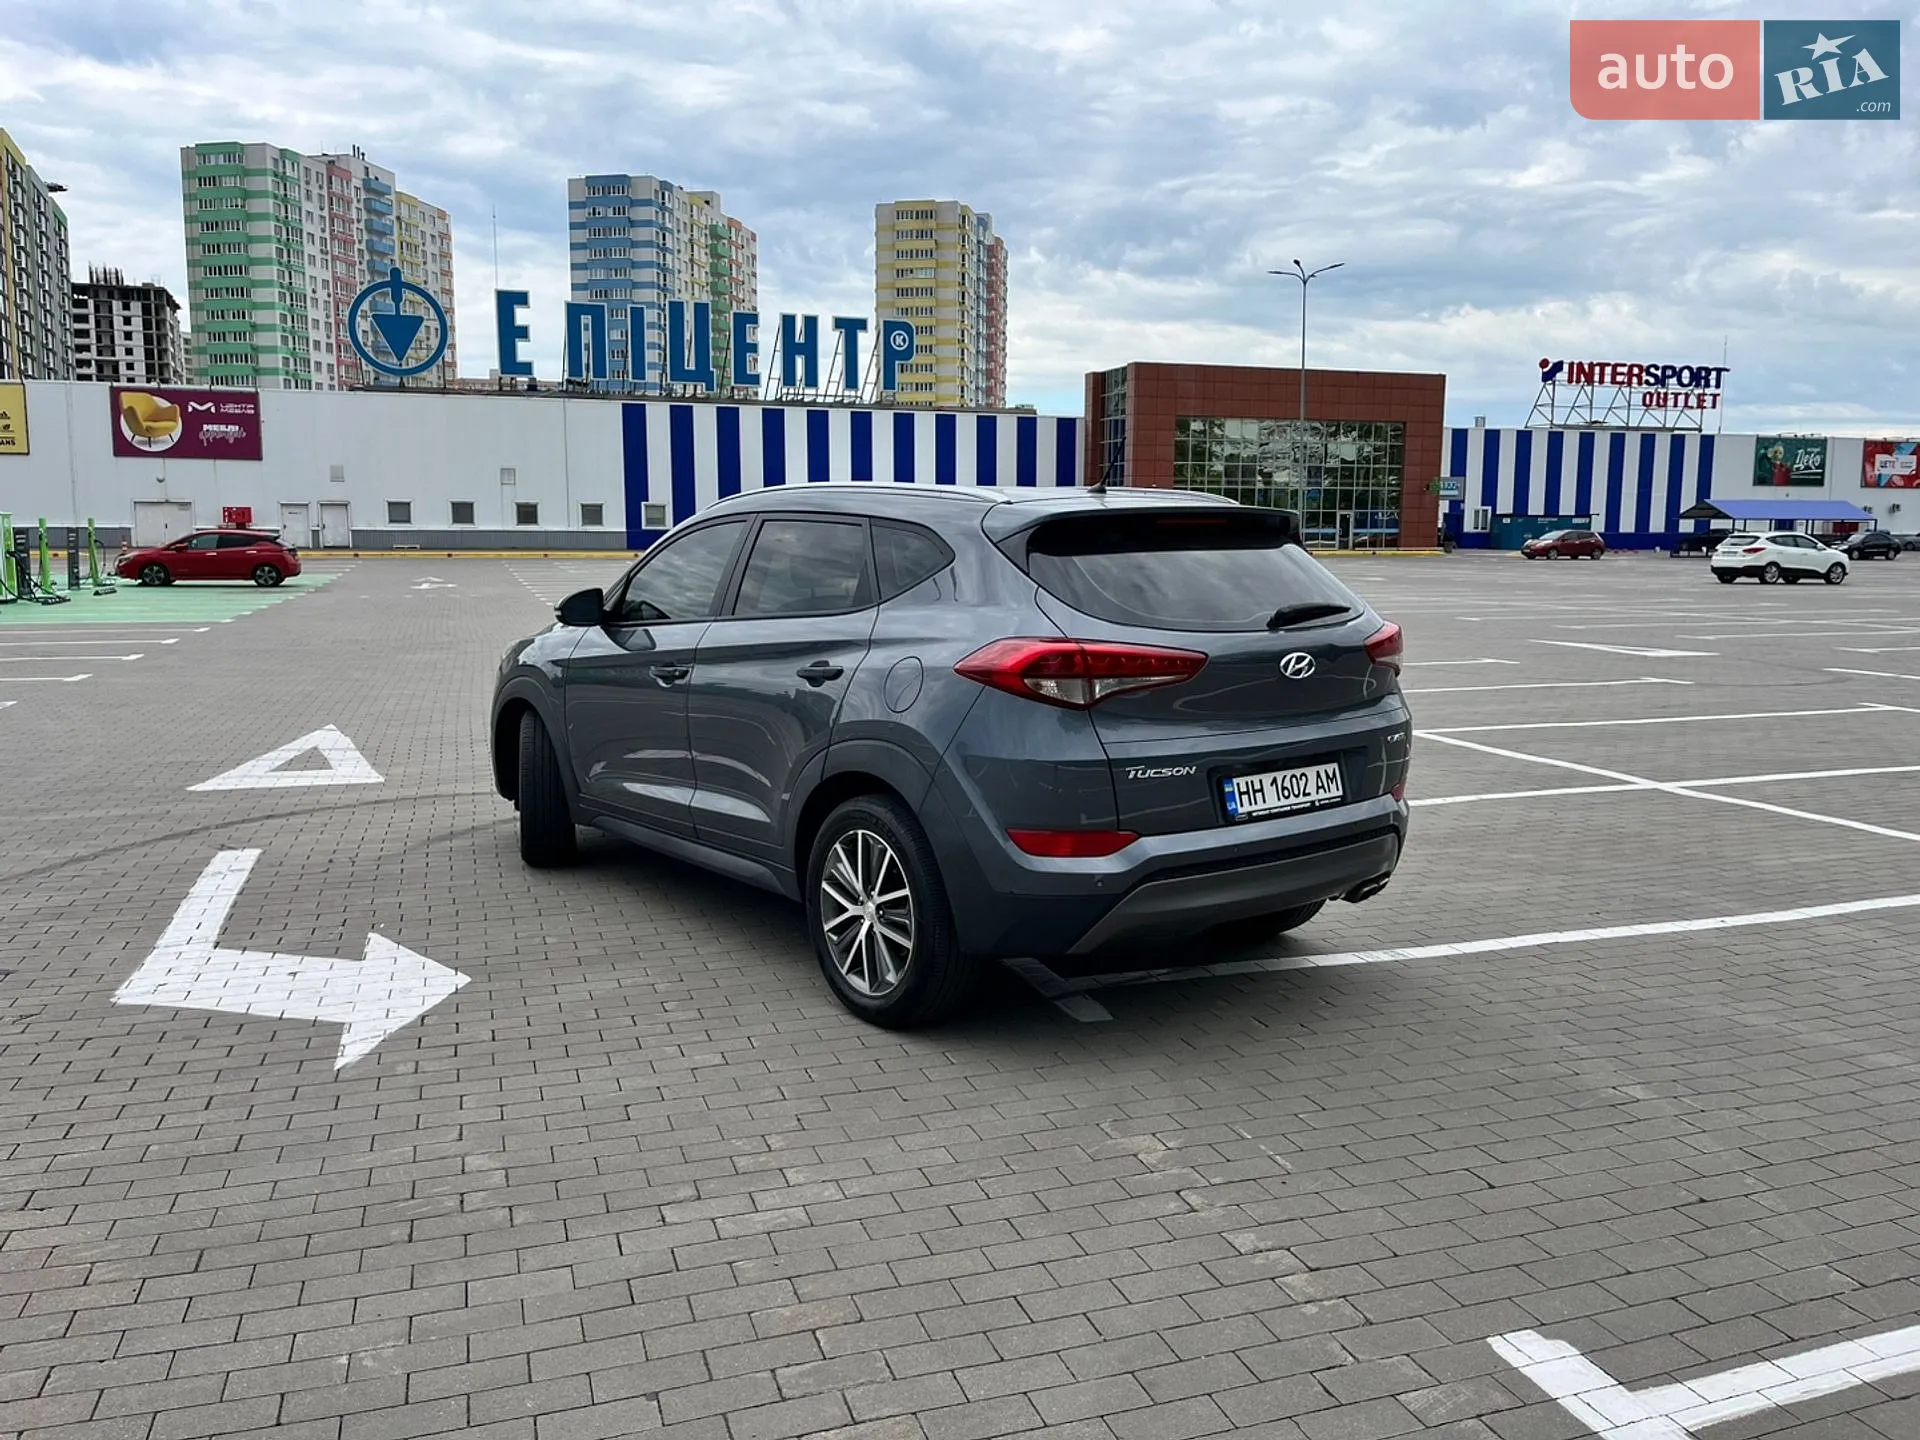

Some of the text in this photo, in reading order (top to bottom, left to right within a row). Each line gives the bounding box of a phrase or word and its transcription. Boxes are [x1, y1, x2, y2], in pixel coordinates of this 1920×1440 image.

[495, 289, 915, 392] ЕПІЦЕНТР
[1567, 361, 1731, 389] INTERSPORT
[1641, 391, 1721, 409] OUTLET
[1236, 767, 1340, 808] HH 1602 AM
